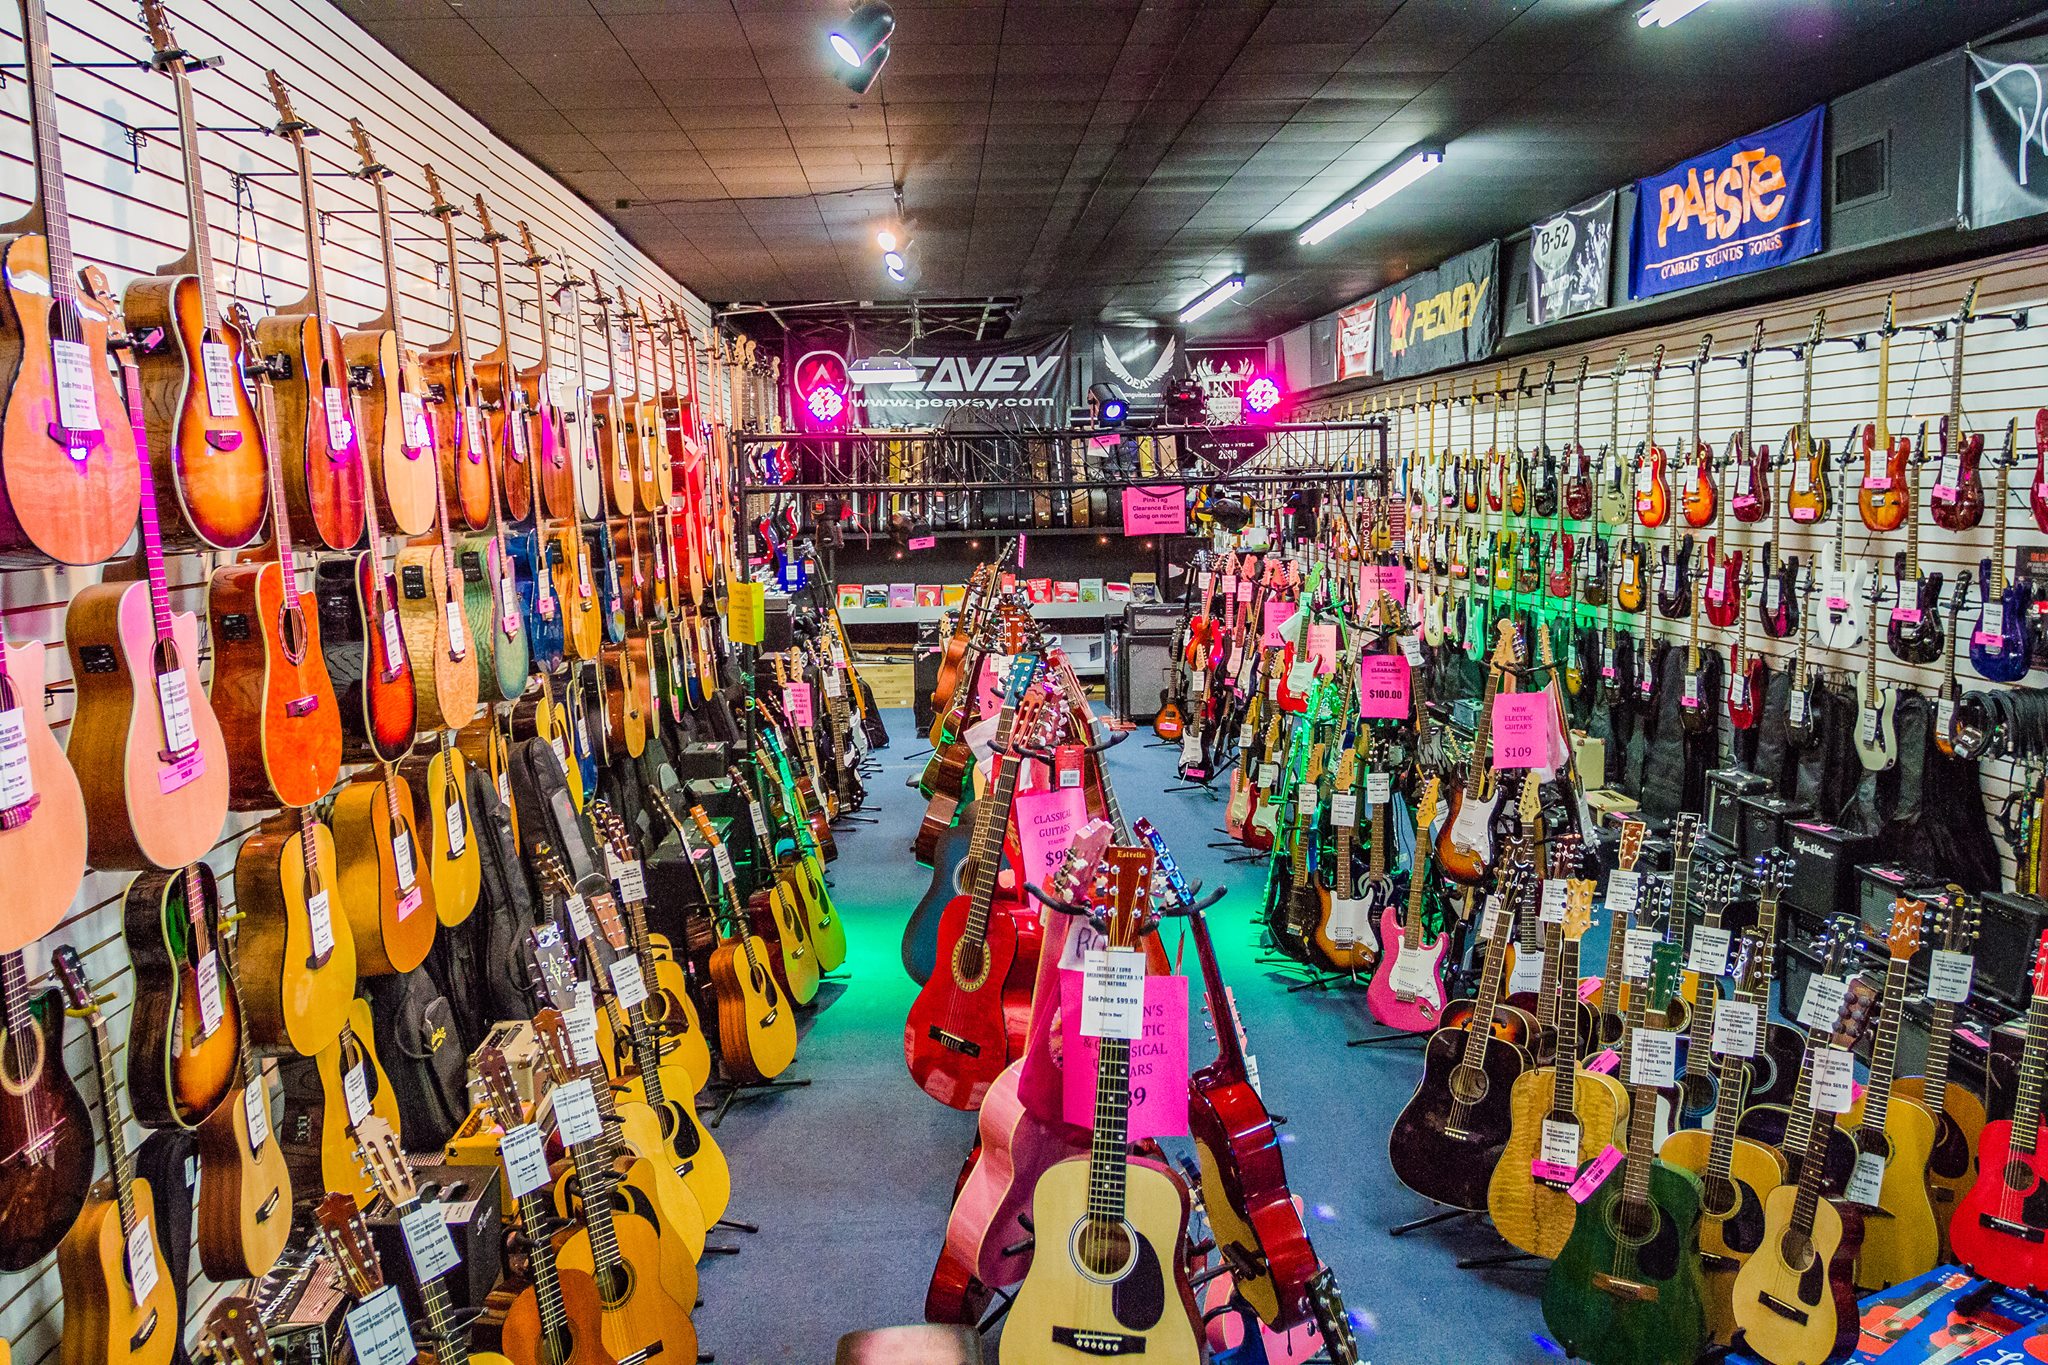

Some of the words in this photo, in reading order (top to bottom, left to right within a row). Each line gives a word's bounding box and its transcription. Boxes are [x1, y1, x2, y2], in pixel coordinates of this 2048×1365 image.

[1541, 224, 1570, 256] B-52
[852, 356, 1060, 392] EAVEY
[1124, 374, 1157, 390] DEAN
[851, 397, 1054, 411] www.peavey.com
[1362, 498, 1370, 516] RENT
[1362, 518, 1370, 528] TO
[1362, 529, 1370, 550] OWN
[1369, 689, 1402, 700] $100.00
[1504, 747, 1532, 758] $109
[1033, 809, 1072, 825] CLASSICAL
[1038, 823, 1071, 838] GUITARS
[363, 1346, 375, 1357] Sale
